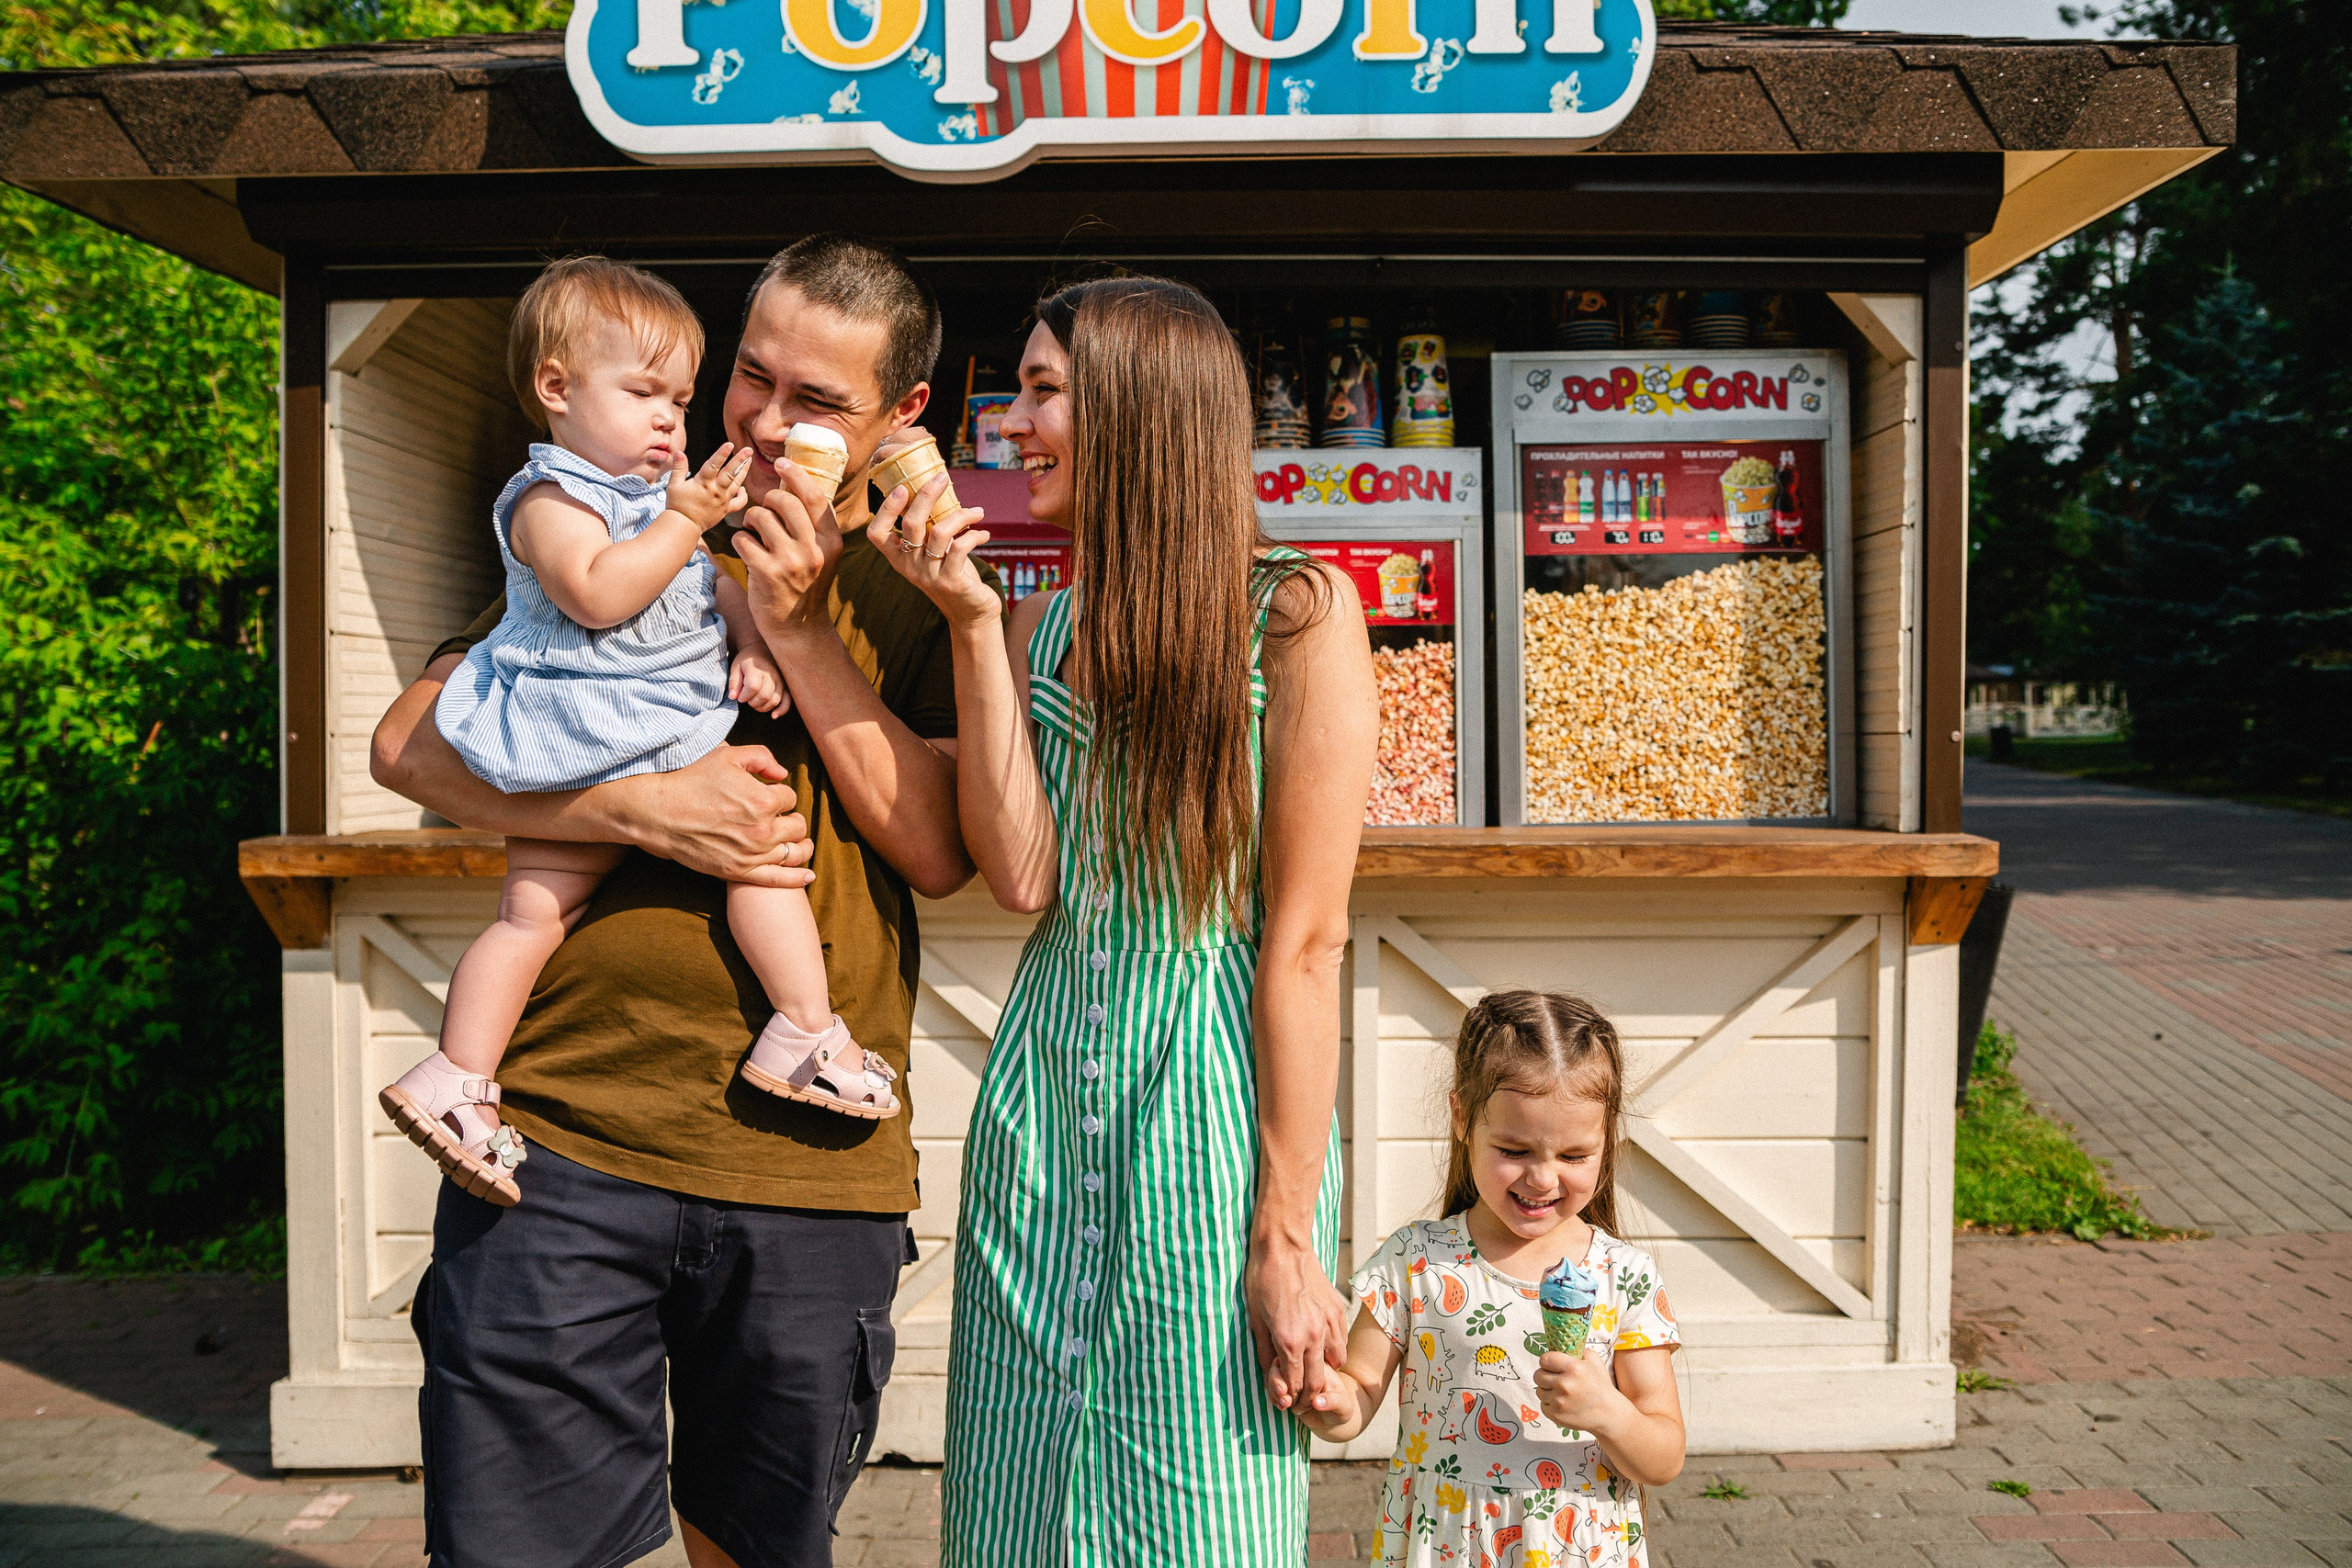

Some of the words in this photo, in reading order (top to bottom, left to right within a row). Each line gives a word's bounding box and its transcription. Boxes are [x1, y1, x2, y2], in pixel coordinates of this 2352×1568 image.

[1562, 366, 1638, 413] POP
[1682, 366, 1788, 411] CORN
[1252, 463, 1306, 504] OP
[1349, 462, 1452, 504] CORN
